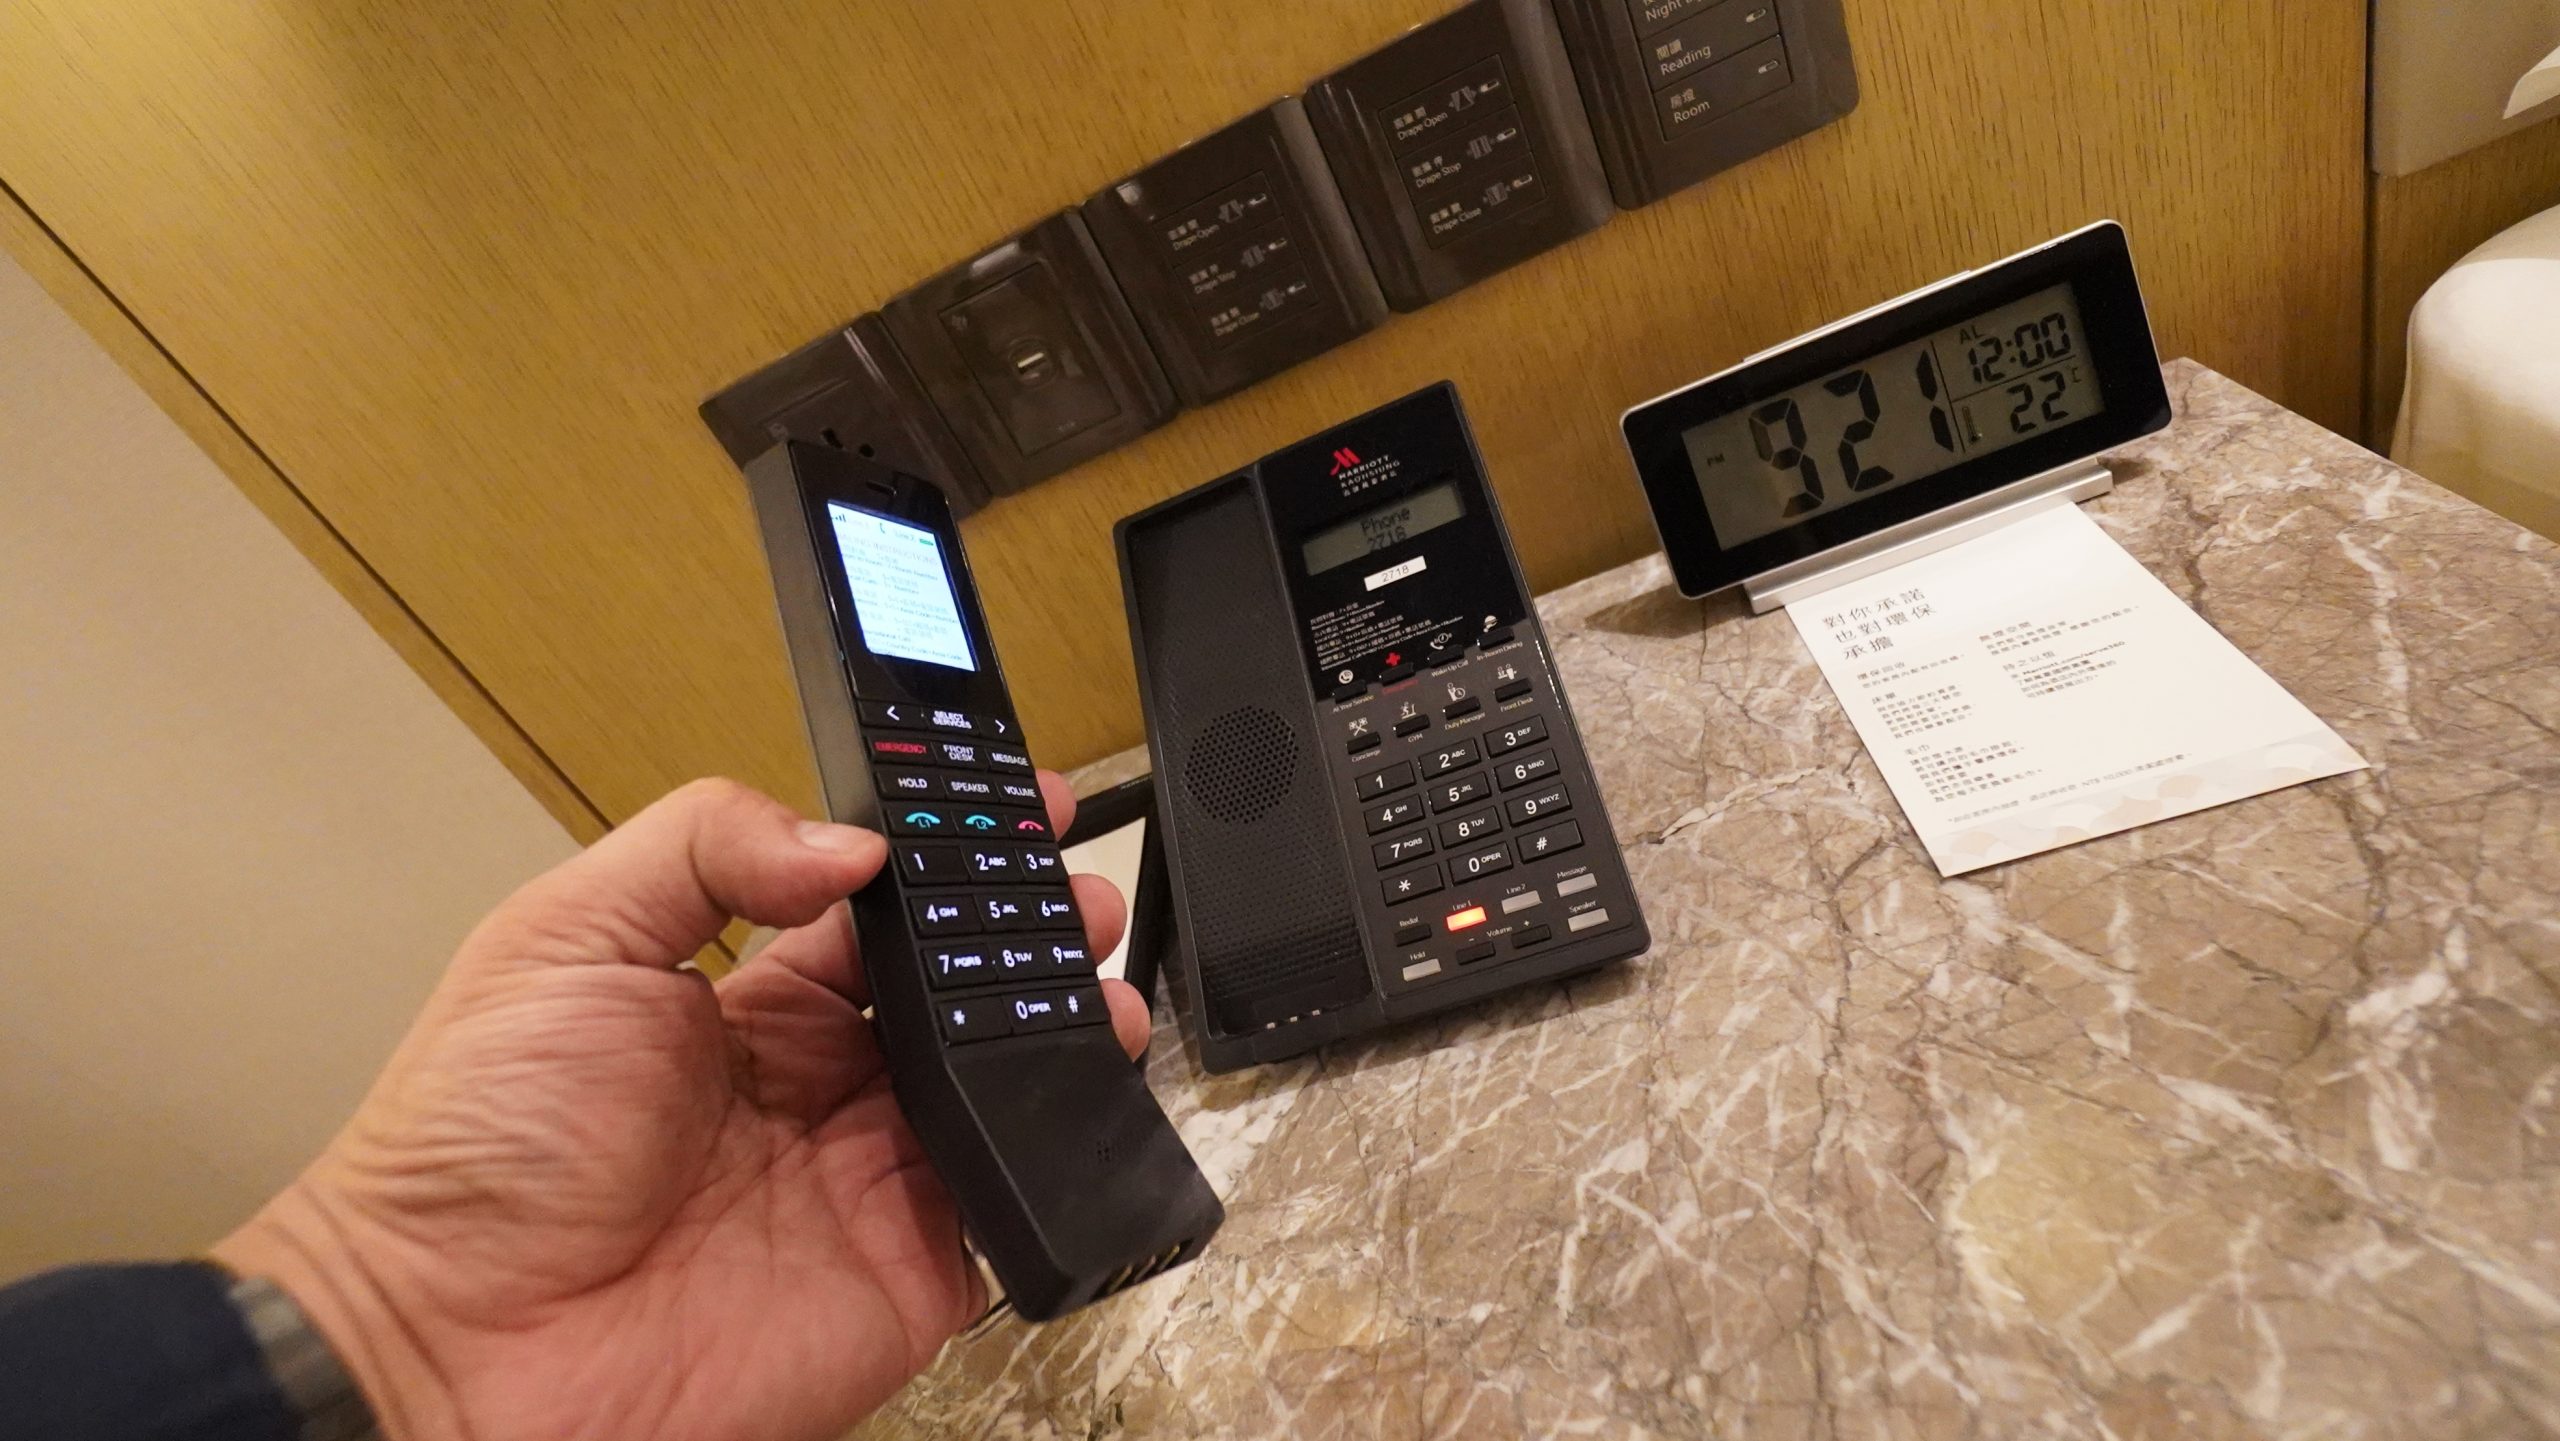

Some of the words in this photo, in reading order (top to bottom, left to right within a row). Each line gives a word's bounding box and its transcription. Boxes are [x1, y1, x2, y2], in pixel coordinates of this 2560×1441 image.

[1645, 0, 1684, 22] Night
[1660, 46, 1711, 76] Reading
[1673, 101, 1711, 124] Room
[1397, 123, 1424, 141] Drape
[1424, 112, 1448, 128] Open
[1416, 171, 1441, 188] Drape
[1441, 162, 1462, 176] Stop
[1433, 217, 1459, 234] Drape
[1459, 207, 1482, 223] Close
[1959, 325, 1984, 345] AL
[1967, 311, 2072, 384] 12:00
[1338, 454, 1390, 480] MARRIOTT
[1340, 460, 1400, 489] KAOHSIUNG
[1361, 507, 1410, 536] Phone
[1382, 564, 1410, 583] 2718
[1821, 588, 1926, 629] 對你承諾
[1834, 602, 1936, 644] 也對環保
[1502, 641, 1523, 654] Dining
[1843, 635, 1895, 661] 承擔
[1455, 660, 1469, 671] Call
[933, 709, 965, 721] SELECT
[1459, 711, 1486, 728] Manager
[1407, 732, 1423, 744] GYM
[1504, 731, 1517, 747] 3
[1517, 726, 1532, 738] DEF
[943, 744, 975, 755] FRONT
[948, 751, 976, 763] DESK
[1438, 752, 1452, 769] 2
[1451, 748, 1466, 758] ABC
[991, 752, 1029, 767] MESSAGE
[1514, 764, 1527, 781] 6
[1527, 758, 1545, 771] MNO
[897, 777, 928, 790] HOLD
[951, 781, 990, 794] SPEAKER
[1375, 773, 1385, 790] 1
[1003, 785, 1037, 798] VOLUME
[1448, 786, 1460, 803] 5
[1460, 783, 1473, 793] JKL
[1382, 808, 1394, 824] 4
[1395, 803, 1408, 814] GHI
[1525, 799, 1538, 816] 9
[1538, 792, 1560, 806] WXYZ
[975, 819, 989, 831] L2
[1458, 821, 1471, 838] 8
[1470, 817, 1486, 829] TUV
[1390, 842, 1402, 859] 7
[1536, 836, 1548, 851] #
[913, 853, 925, 872] 1
[975, 853, 989, 871] 2
[988, 856, 1007, 867] ABC
[1026, 853, 1038, 870] 3
[1038, 857, 1055, 867] DEF
[1468, 856, 1480, 873] 0
[1480, 852, 1502, 864] OPER
[1556, 864, 1587, 878] Message
[1506, 886, 1521, 895] Line
[926, 904, 939, 923] 4
[988, 901, 1001, 919] 5
[1041, 901, 1051, 917] 6
[1051, 904, 1070, 913] MNO
[1452, 903, 1467, 912] Line
[1568, 900, 1598, 914] Speaker
[1399, 915, 1419, 928] Redial
[1486, 924, 1513, 938] Volume
[938, 954, 950, 974] 7
[1002, 949, 1016, 968] 8
[1015, 952, 1033, 963] TUV
[1052, 946, 1063, 964] 9
[1062, 949, 1085, 961] WXYZ
[1409, 951, 1426, 962] Hold
[1015, 1000, 1029, 1020] 0
[1027, 1002, 1052, 1014] OPER
[1067, 994, 1079, 1014] #
